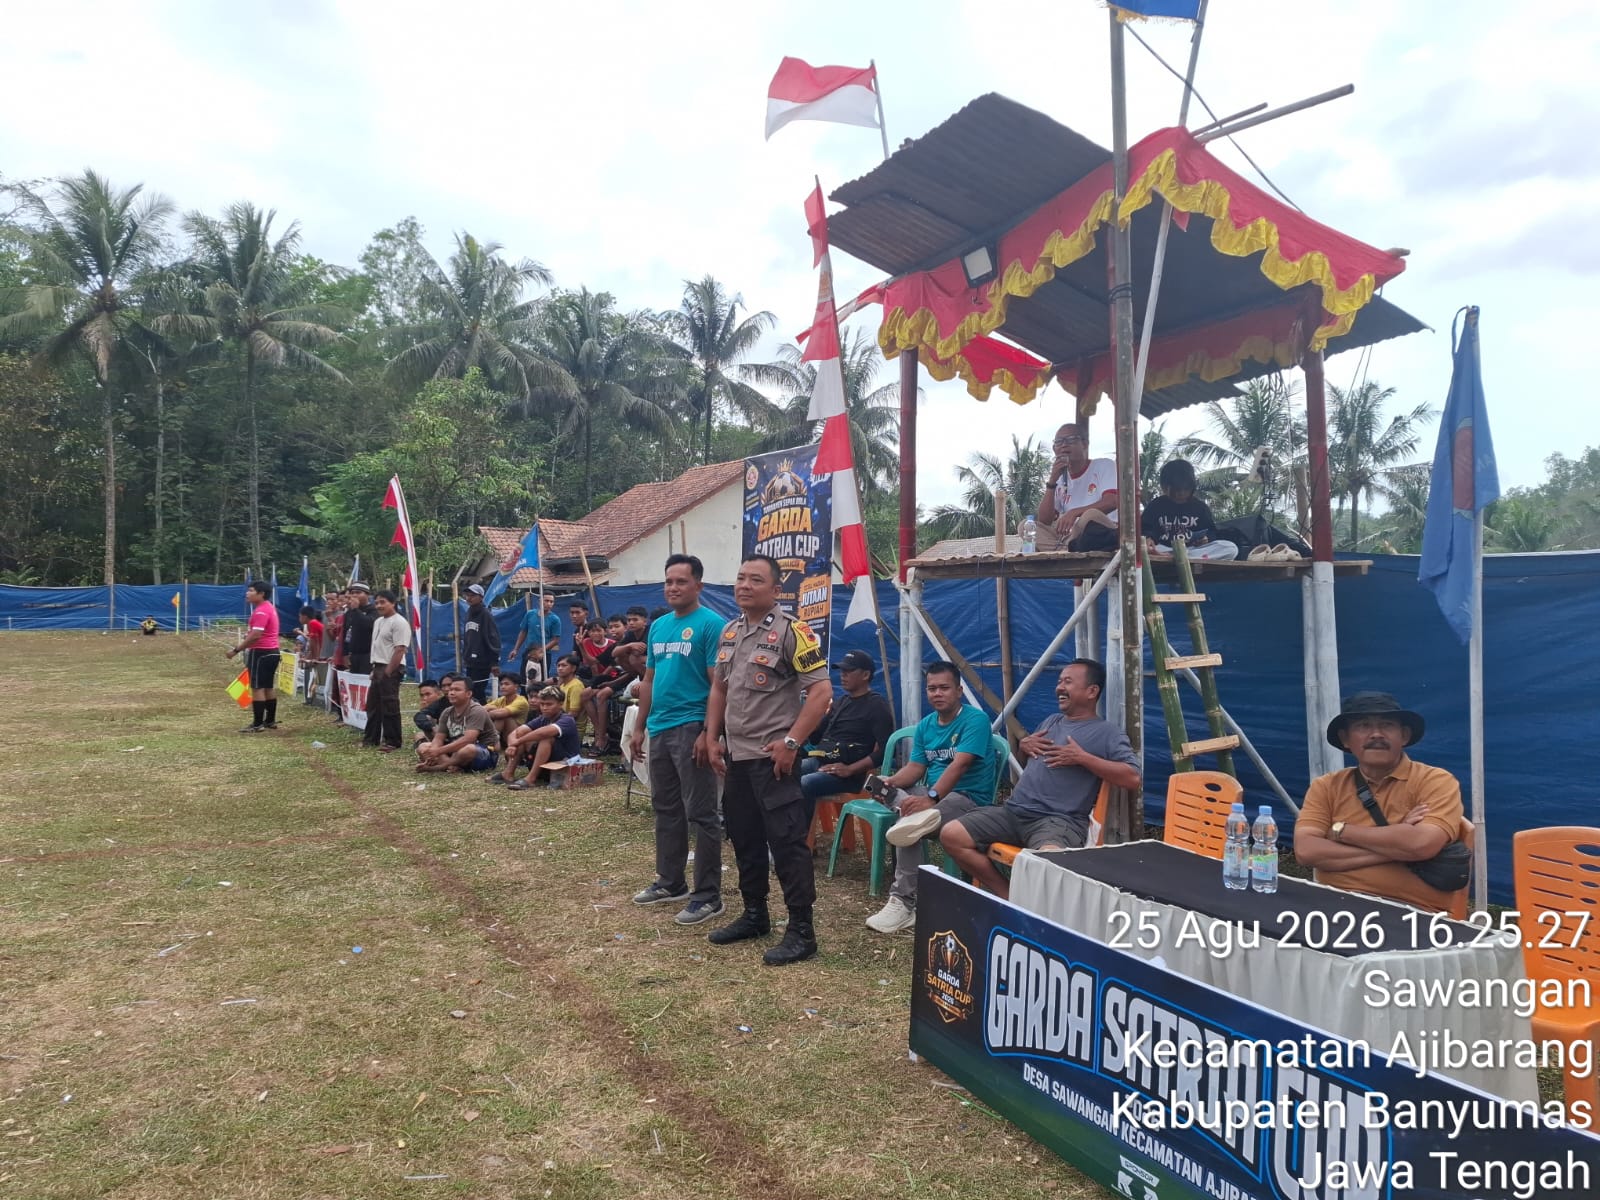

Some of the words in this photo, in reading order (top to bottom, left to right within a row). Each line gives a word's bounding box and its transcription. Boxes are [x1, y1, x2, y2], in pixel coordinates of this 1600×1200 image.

[757, 507, 812, 542] GARDA
[754, 535, 792, 559] SATRIA
[795, 534, 820, 558] CUP
[800, 586, 828, 608] JUTAAN
[803, 603, 824, 618] RUPIAH
[756, 643, 780, 653] POLRI
[926, 972, 954, 997] SATRIA
[954, 987, 971, 1005] CUP
[937, 968, 960, 988] GARDA
[987, 933, 1093, 1061] GARDA
[1103, 985, 1259, 1165] SATRIA
[1023, 1062, 1050, 1095] DESA
[1121, 1120, 1202, 1188] KECAMATAN
[1124, 1160, 1154, 1183] SPONSOR
